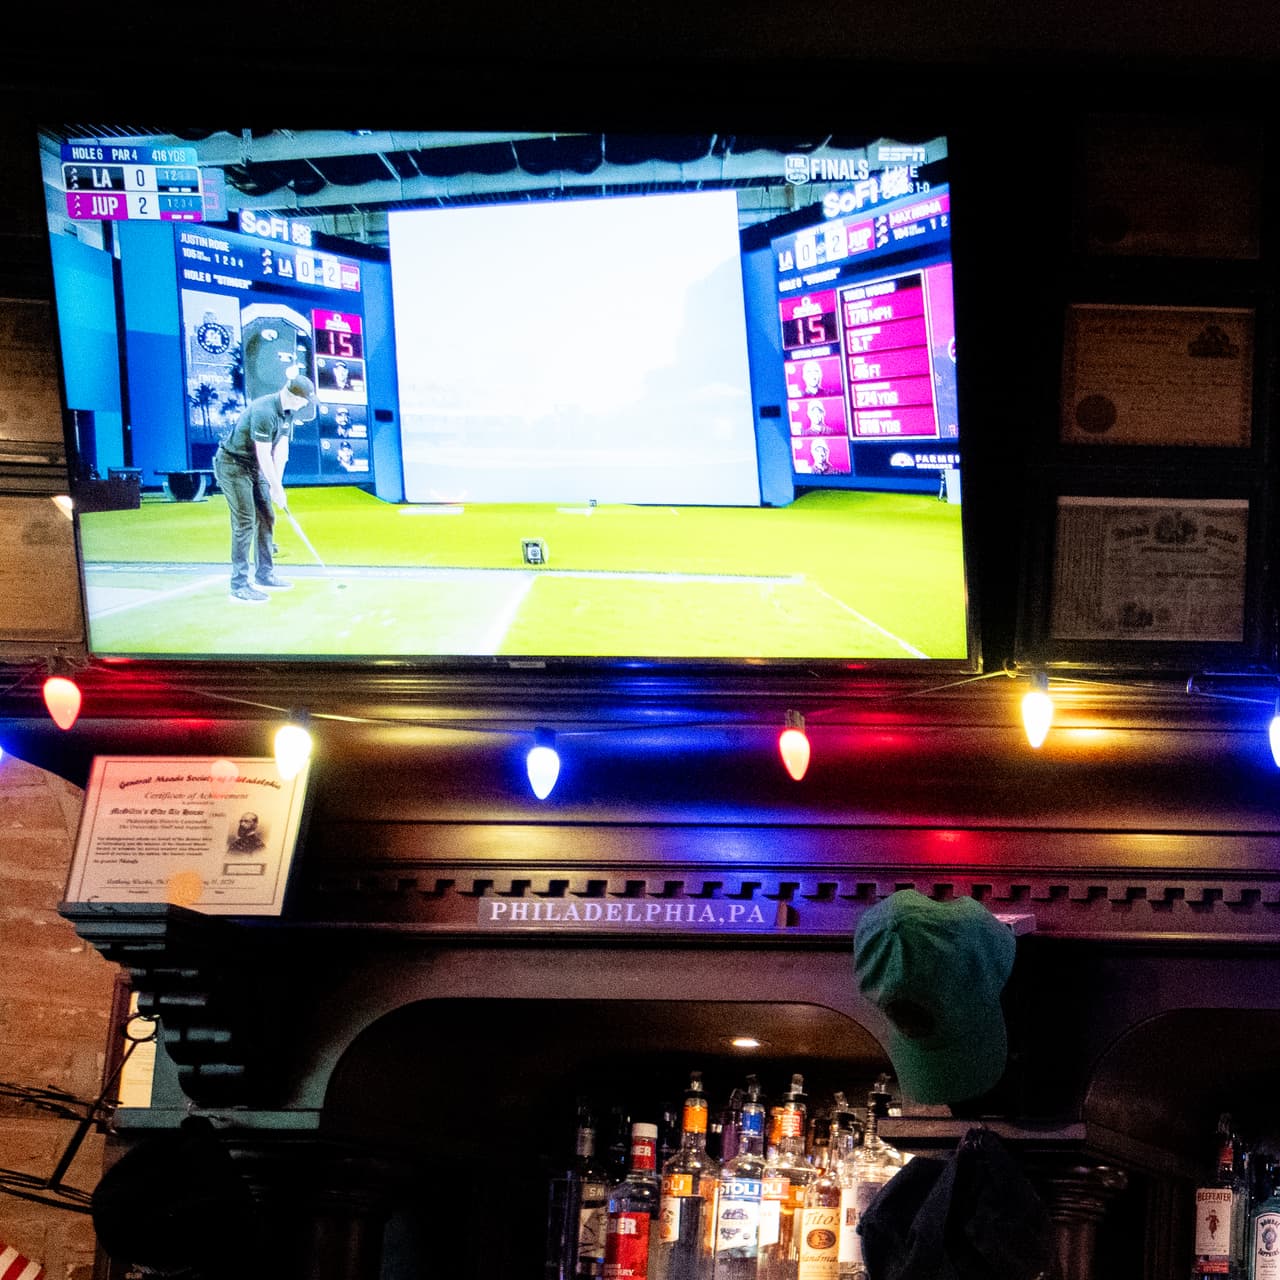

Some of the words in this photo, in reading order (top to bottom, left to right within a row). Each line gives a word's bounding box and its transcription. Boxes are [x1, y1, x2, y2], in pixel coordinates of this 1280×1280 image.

[72, 147, 98, 160] HOLE
[97, 149, 103, 160] 6
[112, 151, 130, 161] PAR
[132, 151, 137, 161] 4
[152, 150, 166, 161] 416
[168, 151, 185, 161] YDS
[878, 146, 925, 162] ESPN
[92, 168, 112, 188] LA
[136, 169, 145, 187] 0
[811, 159, 869, 180] FINALS
[91, 196, 119, 216] JUP
[139, 197, 148, 214] 2
[823, 178, 879, 218] SoFi
[241, 210, 289, 241] SoFi
[278, 258, 293, 276] LA
[302, 261, 309, 277] 0
[779, 250, 793, 271] LA
[799, 316, 825, 344] 15
[330, 332, 353, 356] 15
[119, 777, 153, 789] General
[1197, 1192, 1231, 1202] BEEFEATER
[804, 1211, 840, 1226] Tito's
